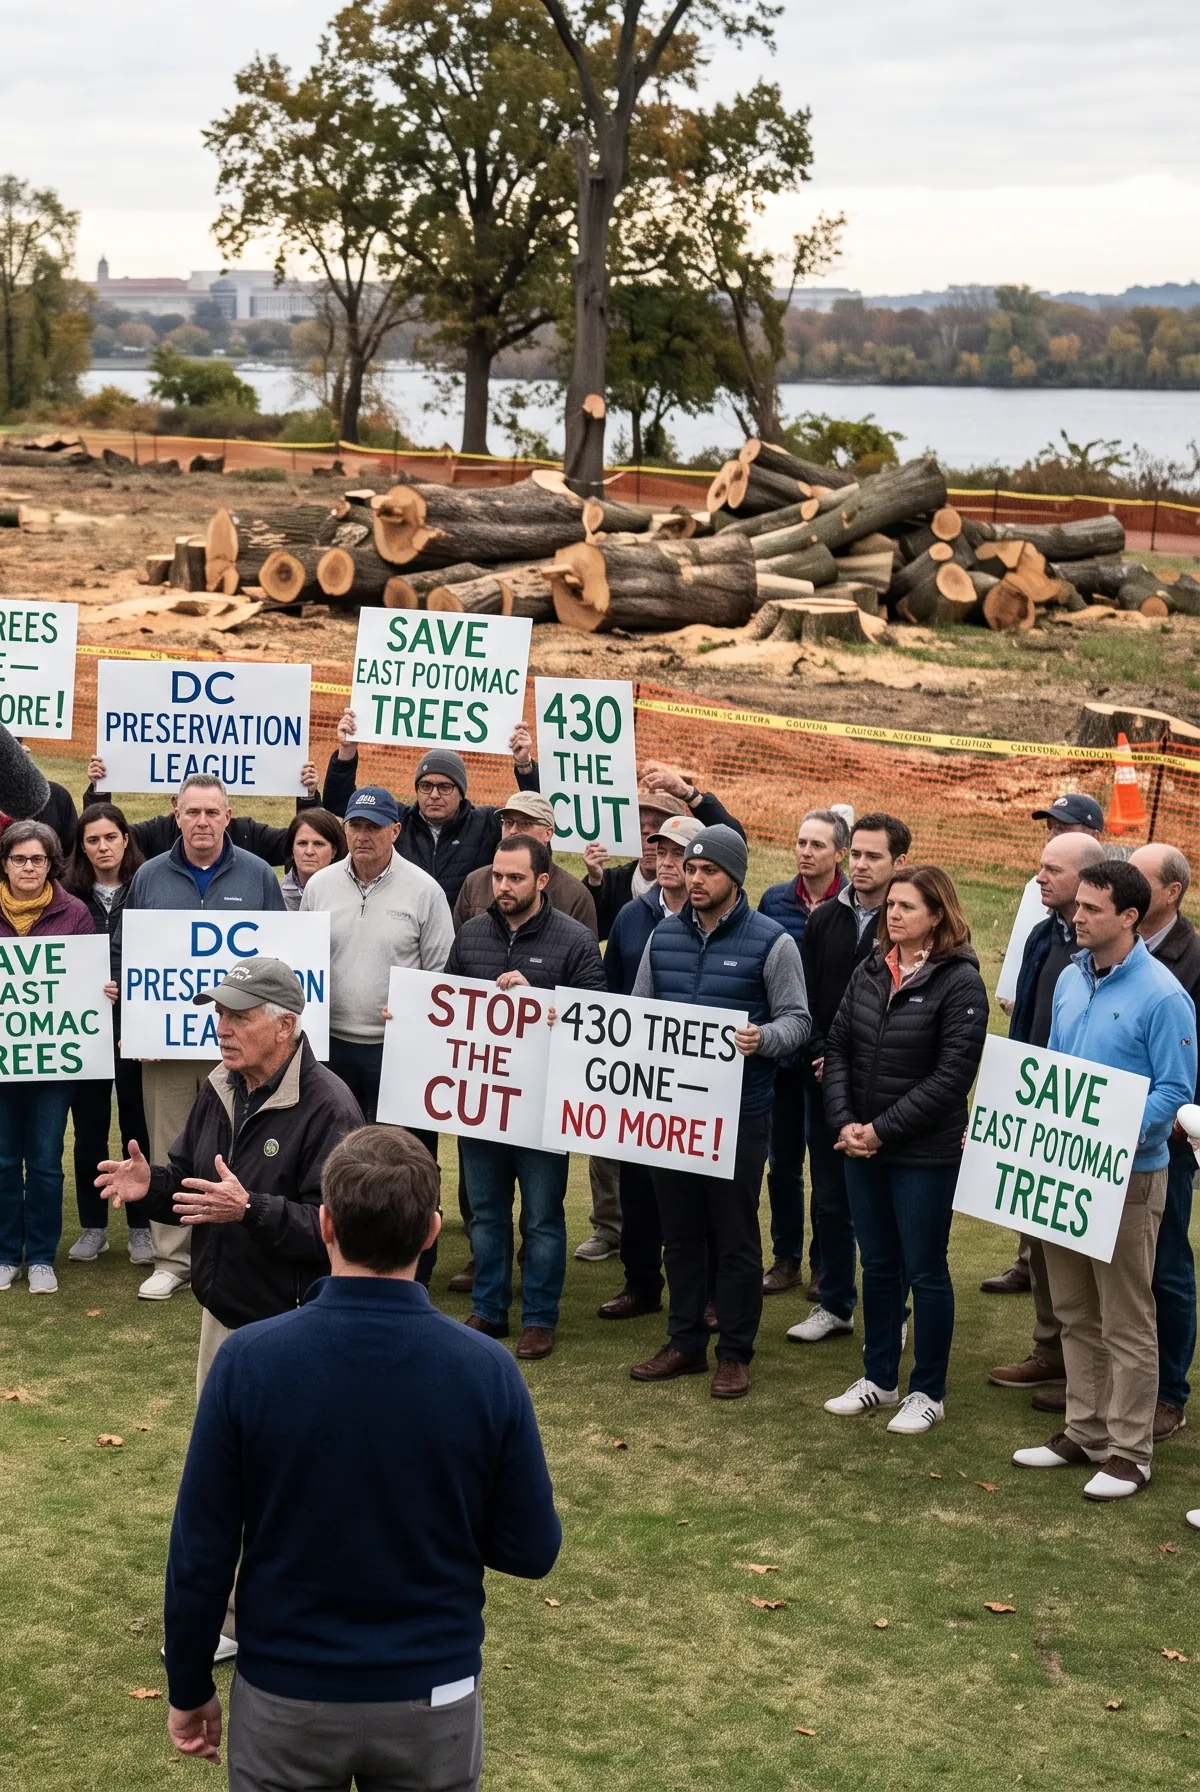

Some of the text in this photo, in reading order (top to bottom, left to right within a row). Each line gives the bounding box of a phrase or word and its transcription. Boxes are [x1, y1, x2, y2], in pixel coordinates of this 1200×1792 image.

[387, 615, 489, 659] SAVE
[171, 670, 235, 705] DC
[356, 658, 517, 695] EAST POTOMAC
[105, 712, 301, 746] PRESERVATION
[371, 694, 488, 743] TREES
[543, 693, 622, 745] 430
[150, 753, 253, 785] LEAGUE
[554, 751, 612, 786] THE
[550, 792, 630, 843] CUT
[190, 920, 259, 959] DC
[428, 984, 541, 1038] STOP
[560, 1002, 737, 1062] 430 TREES
[446, 1038, 512, 1076] THE
[424, 1076, 521, 1131] CUT
[1015, 1057, 1108, 1127] SAVE
[560, 1099, 724, 1162] NO MORE!
[971, 1105, 1128, 1186] EAST POTOMAC
[995, 1162, 1092, 1239] TREES
